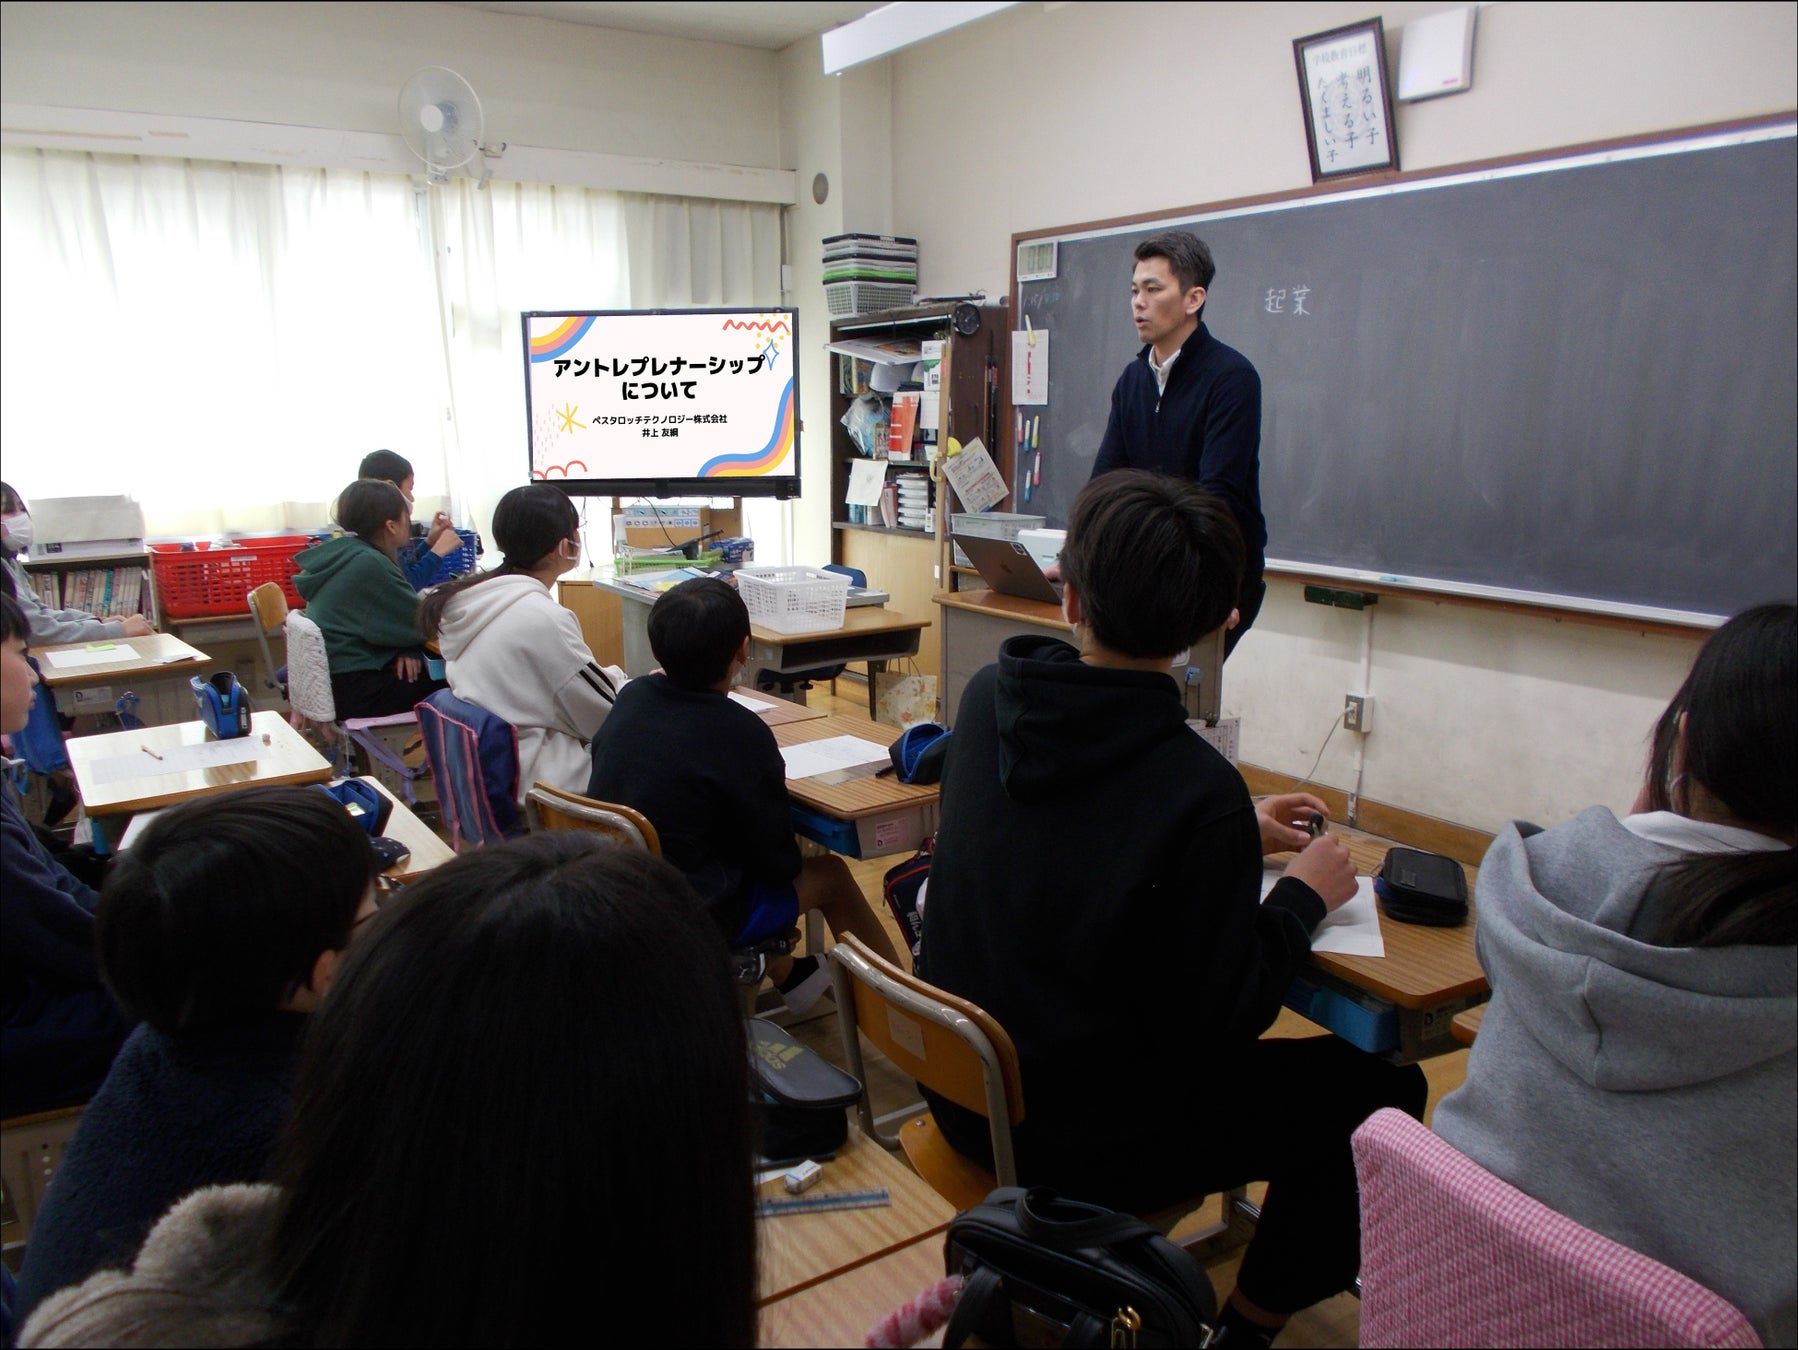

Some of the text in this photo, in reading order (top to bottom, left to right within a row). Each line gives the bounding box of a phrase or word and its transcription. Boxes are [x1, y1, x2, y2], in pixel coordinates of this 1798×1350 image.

[1317, 77, 1339, 163] たくましい子
[1336, 71, 1359, 149] 考える子
[1356, 65, 1380, 145] 明るい子
[1264, 284, 1311, 315] 起業
[553, 353, 766, 378] アントレプレナーシップ
[622, 380, 698, 400] について
[642, 428, 659, 438] 井上
